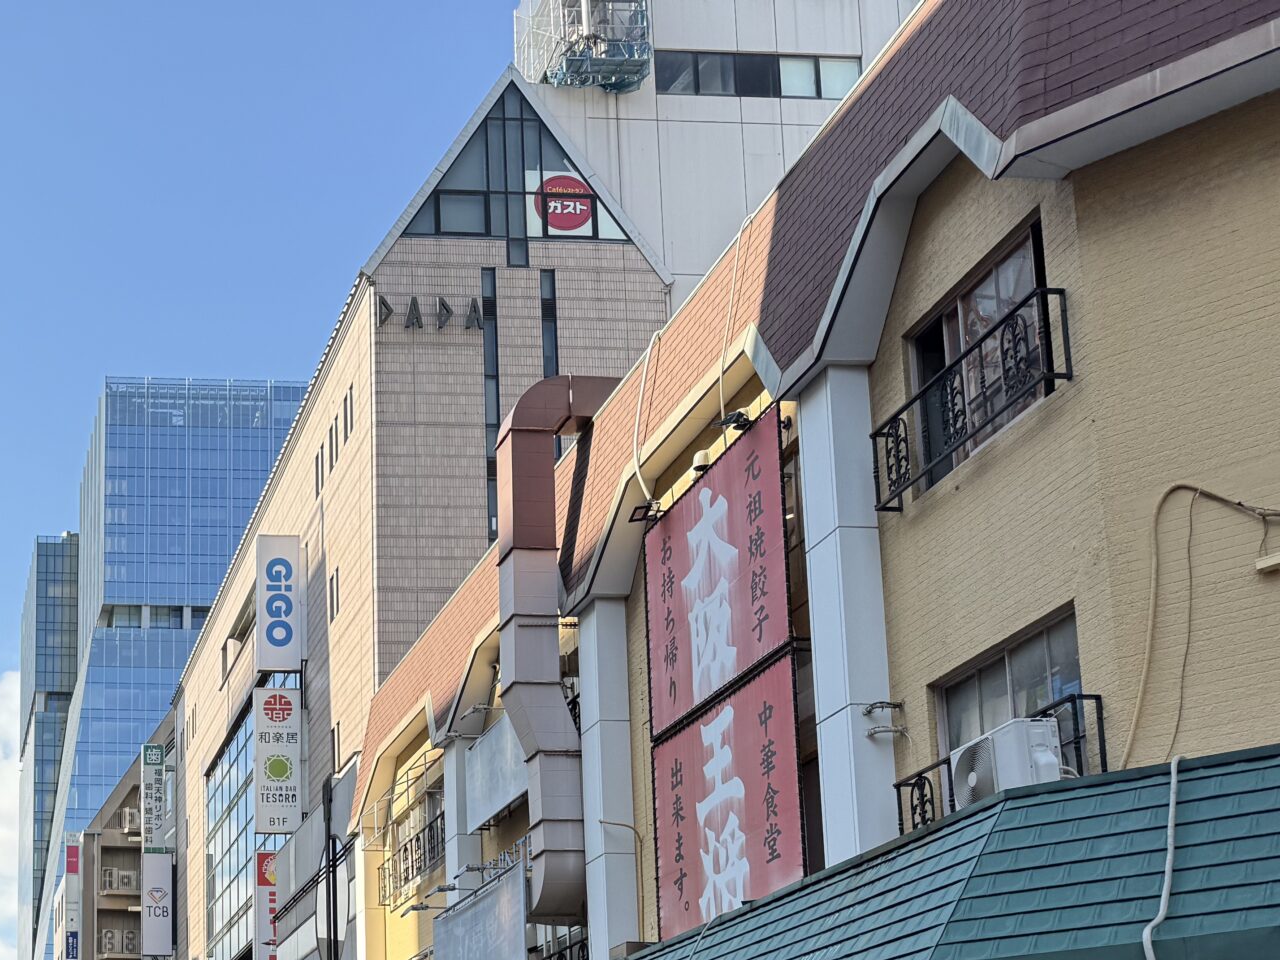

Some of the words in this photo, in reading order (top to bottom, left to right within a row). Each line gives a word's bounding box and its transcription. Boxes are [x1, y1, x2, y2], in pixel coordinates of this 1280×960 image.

[547, 200, 587, 214] ガスト
[377, 295, 484, 330] DADA
[744, 450, 769, 643] 元祖焼餃子
[266, 558, 293, 647] GiGO
[681, 487, 738, 702] 大阪
[660, 535, 677, 705] お持ち帰り
[146, 749, 161, 764] 歯
[258, 732, 298, 744] 和楽居
[154, 769, 163, 831] 福岡天神リボン
[260, 793, 297, 803] TESORO
[757, 700, 782, 864] 中華食堂
[269, 817, 288, 827] B1F
[696, 704, 750, 922] 王将
[146, 905, 169, 918] TCB
